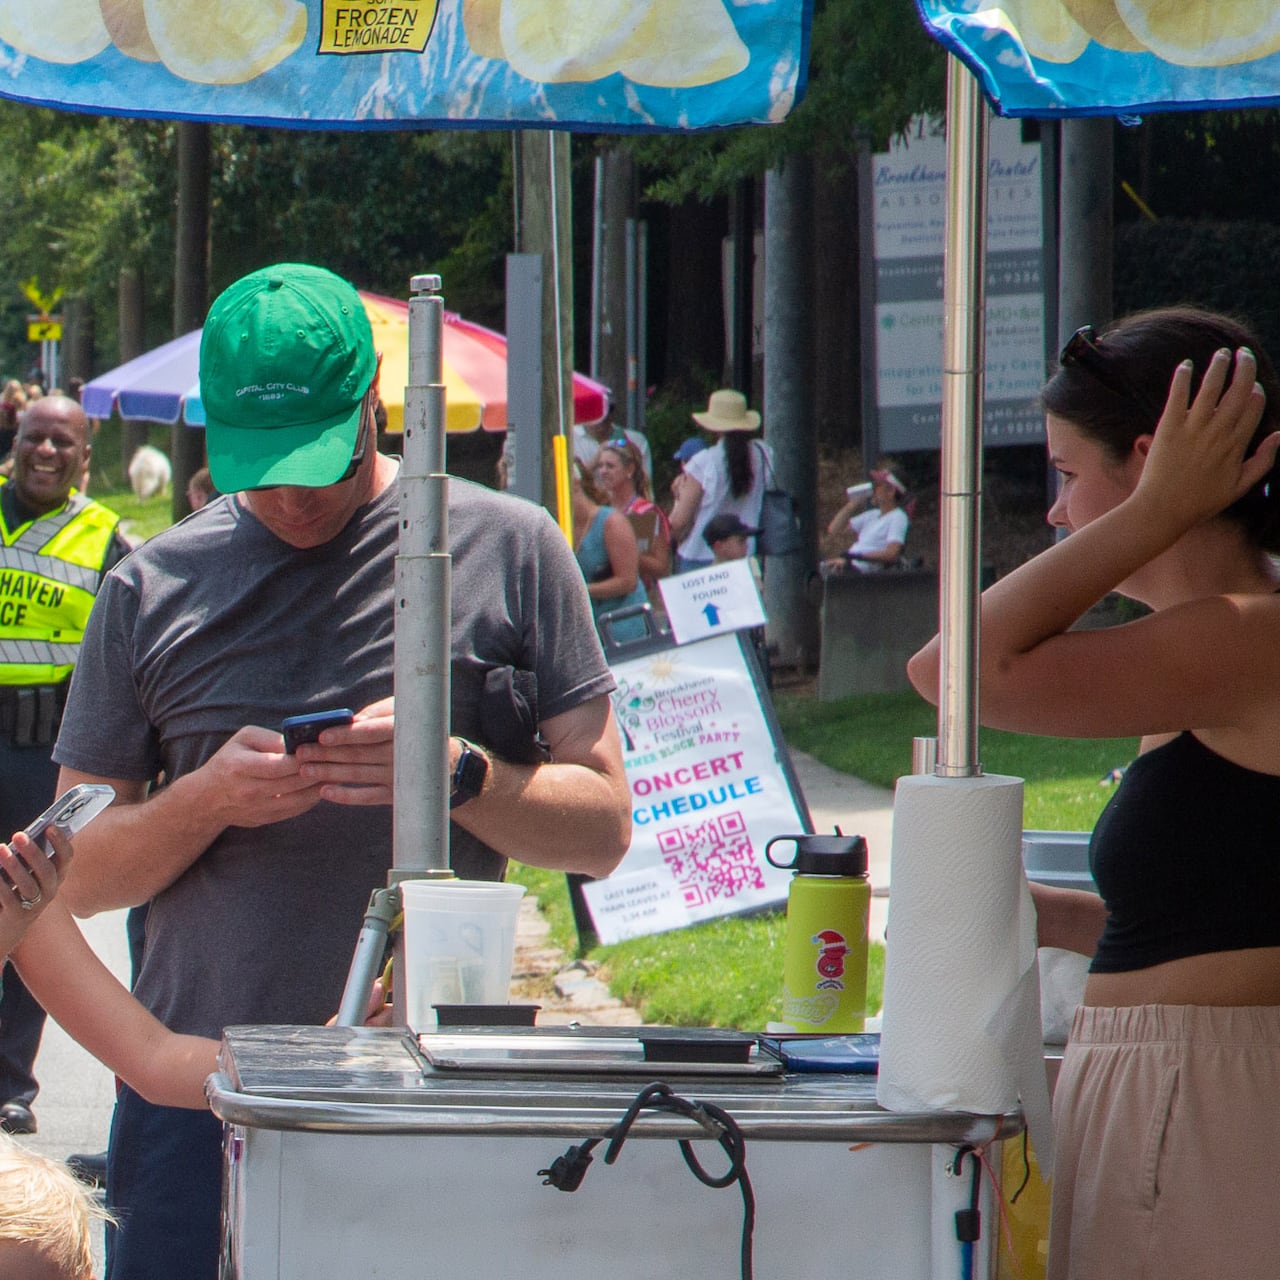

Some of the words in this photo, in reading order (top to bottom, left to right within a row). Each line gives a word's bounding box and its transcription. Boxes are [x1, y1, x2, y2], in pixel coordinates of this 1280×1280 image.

[335, 8, 418, 27] FROZEN
[333, 27, 414, 47] LEMONADE
[875, 163, 946, 184] Brookhav
[235, 385, 265, 397] CAPITAL
[266, 383, 285, 391] CITY
[286, 383, 310, 394] CLUB
[682, 576, 706, 590] LOST
[708, 571, 730, 583] AND
[692, 587, 728, 602] FOUND
[654, 675, 715, 699] Brookhaven
[657, 688, 719, 713] Cherry
[645, 700, 723, 732] Blossom
[653, 720, 704, 744] Festival
[659, 738, 696, 758] BLOCK
[699, 730, 741, 745] PARTY
[633, 751, 745, 797] ONCERT
[633, 776, 764, 826] CHEDULE
[604, 889, 624, 901] LAST
[626, 881, 658, 895] MARTA
[599, 902, 625, 913] TRAIN
[626, 894, 659, 907] LEAVES
